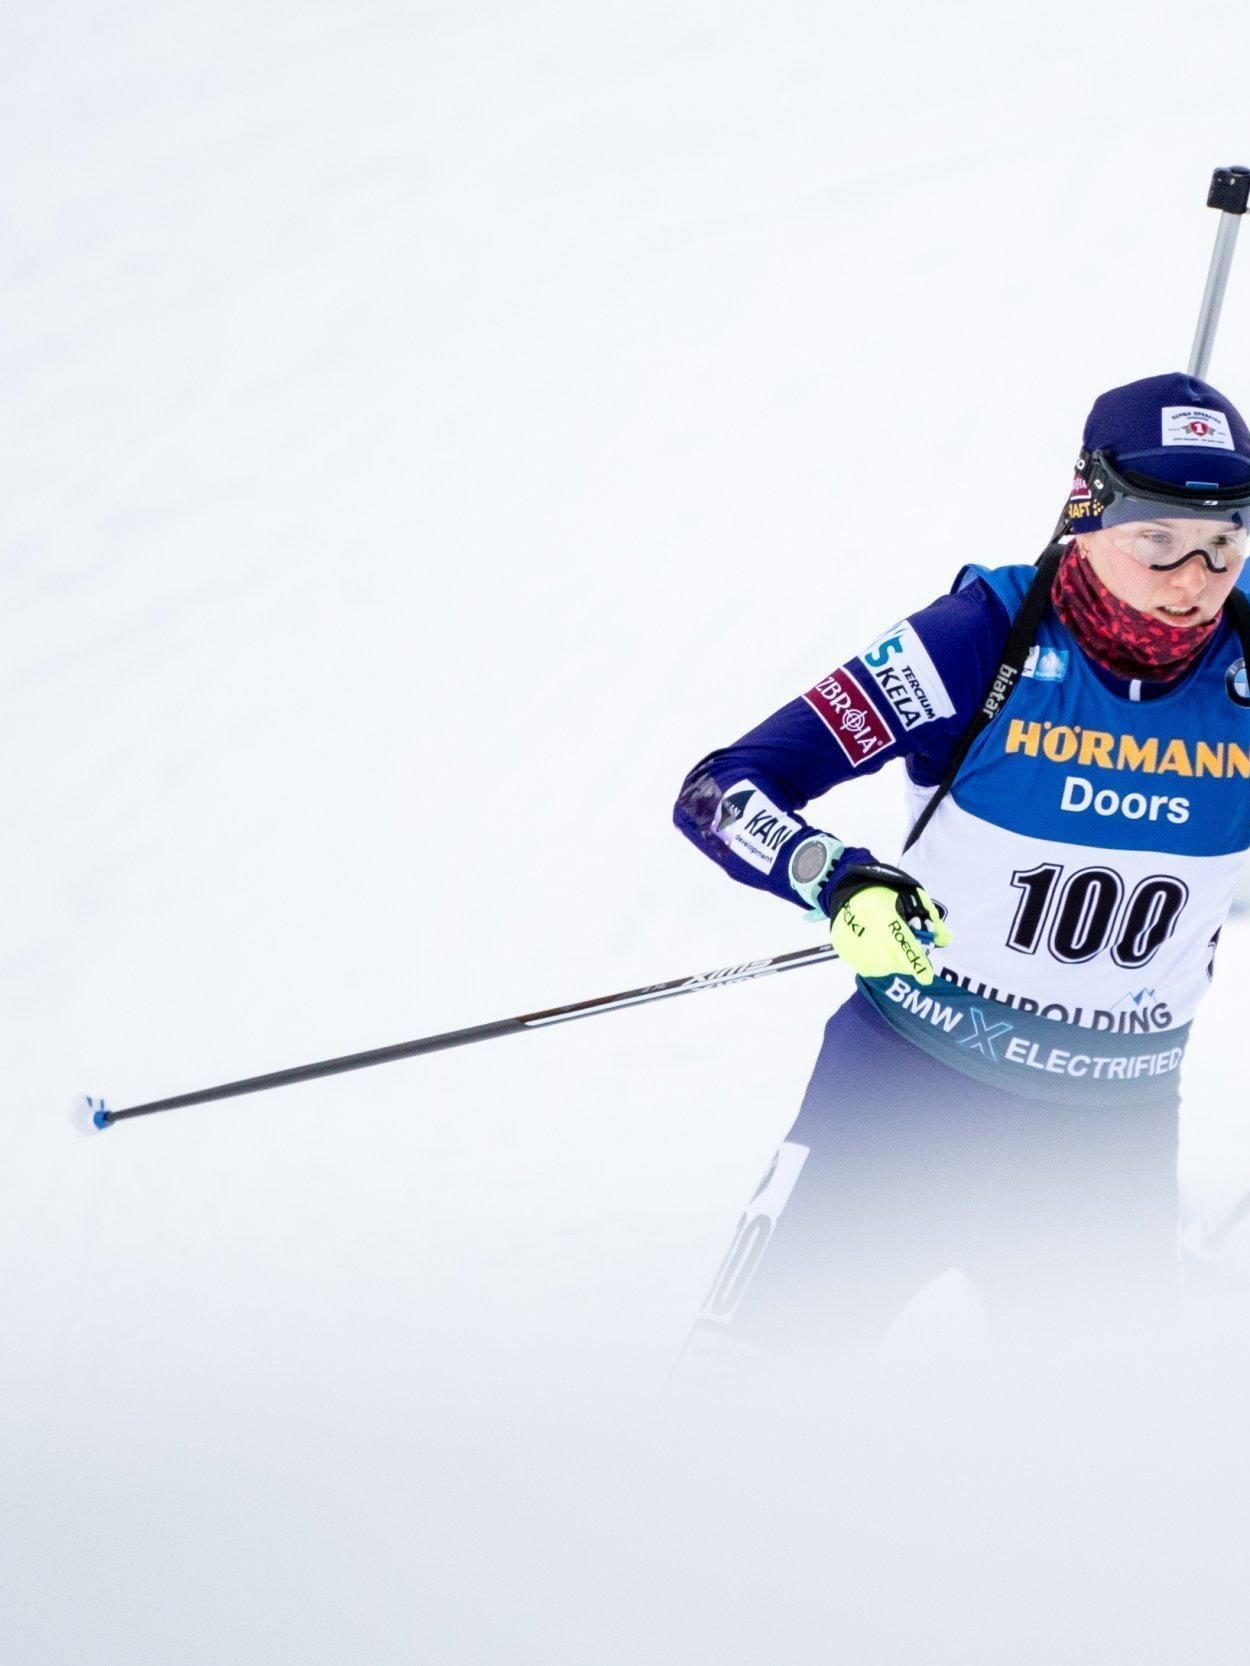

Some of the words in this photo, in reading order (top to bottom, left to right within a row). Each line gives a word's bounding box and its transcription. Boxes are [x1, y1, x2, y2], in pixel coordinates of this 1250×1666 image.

[1068, 502, 1091, 518] AFT
[902, 665, 935, 719] TERCIUM
[983, 664, 1017, 719] biatar
[1060, 776, 1190, 824] Doors
[735, 834, 773, 864] development
[744, 809, 793, 851] KAN
[1004, 862, 1190, 970] 100
[885, 976, 964, 1032] BMW
[1005, 1036, 1183, 1080] ELECTRIFIED
